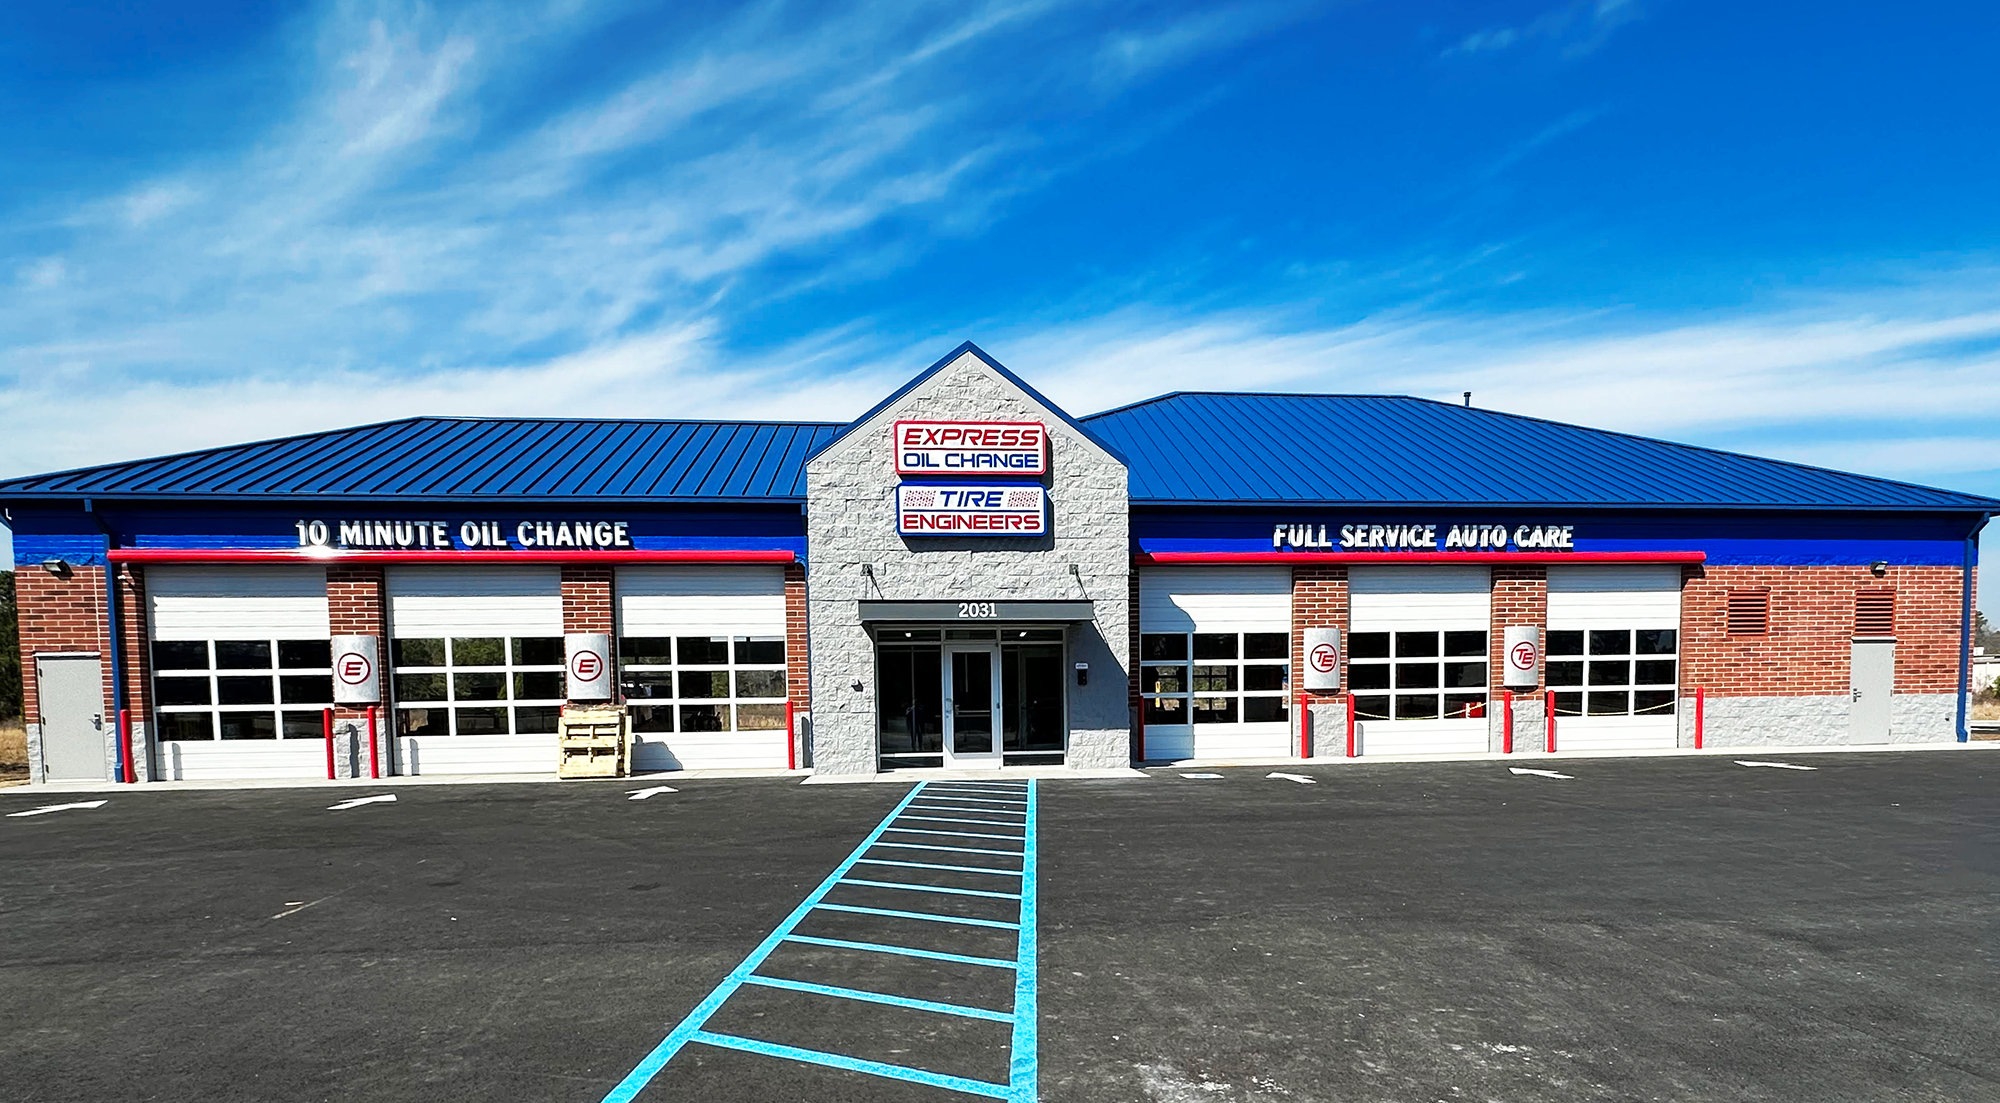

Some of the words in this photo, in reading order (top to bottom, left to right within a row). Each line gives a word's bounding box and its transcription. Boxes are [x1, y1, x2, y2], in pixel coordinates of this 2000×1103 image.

[903, 428, 1040, 446] EXPRESS
[903, 453, 939, 468] OIL
[945, 453, 1039, 468] CHANGE
[940, 490, 1004, 508] TIRE
[903, 514, 1040, 530] ENGINEERS
[295, 519, 330, 546] 10
[339, 520, 449, 546] MINUTE
[460, 521, 507, 546] OIL
[517, 521, 629, 546] CHANGE
[1273, 524, 1332, 547] FULL
[1339, 524, 1437, 547] SERVICE
[1445, 525, 1507, 547] AUTO
[1513, 525, 1574, 547] CARE
[958, 602, 998, 618] 2031
[1315, 650, 1335, 667] TE
[1515, 648, 1534, 664] TE
[344, 661, 364, 676] E
[578, 658, 597, 673] E
